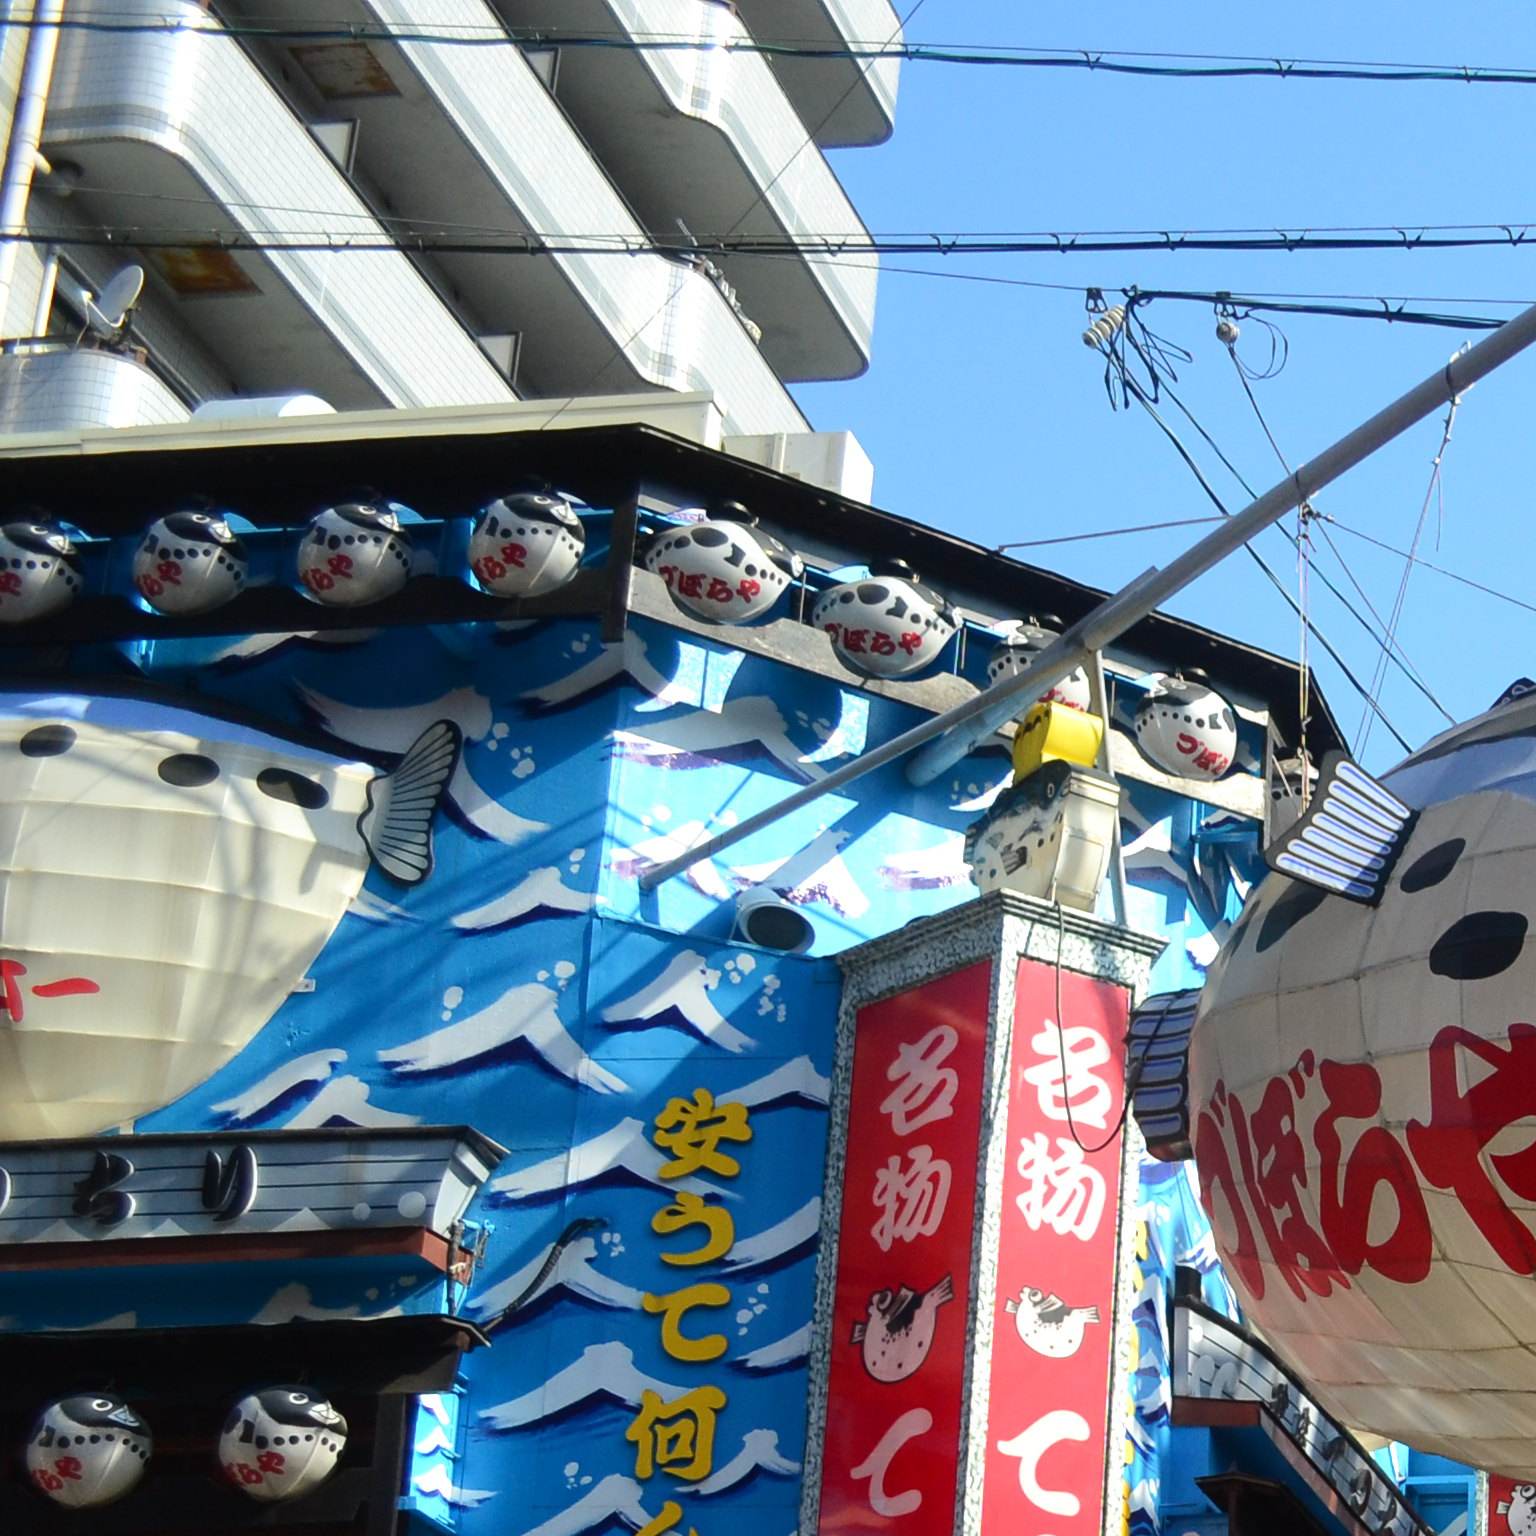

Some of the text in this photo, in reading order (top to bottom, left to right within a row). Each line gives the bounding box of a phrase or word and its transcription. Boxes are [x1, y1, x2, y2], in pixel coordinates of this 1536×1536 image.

[660, 564, 761, 604] づぼらや
[825, 622, 923, 657] づぼらや
[869, 1024, 960, 1252] 名物
[1015, 1019, 1111, 1242] 名物
